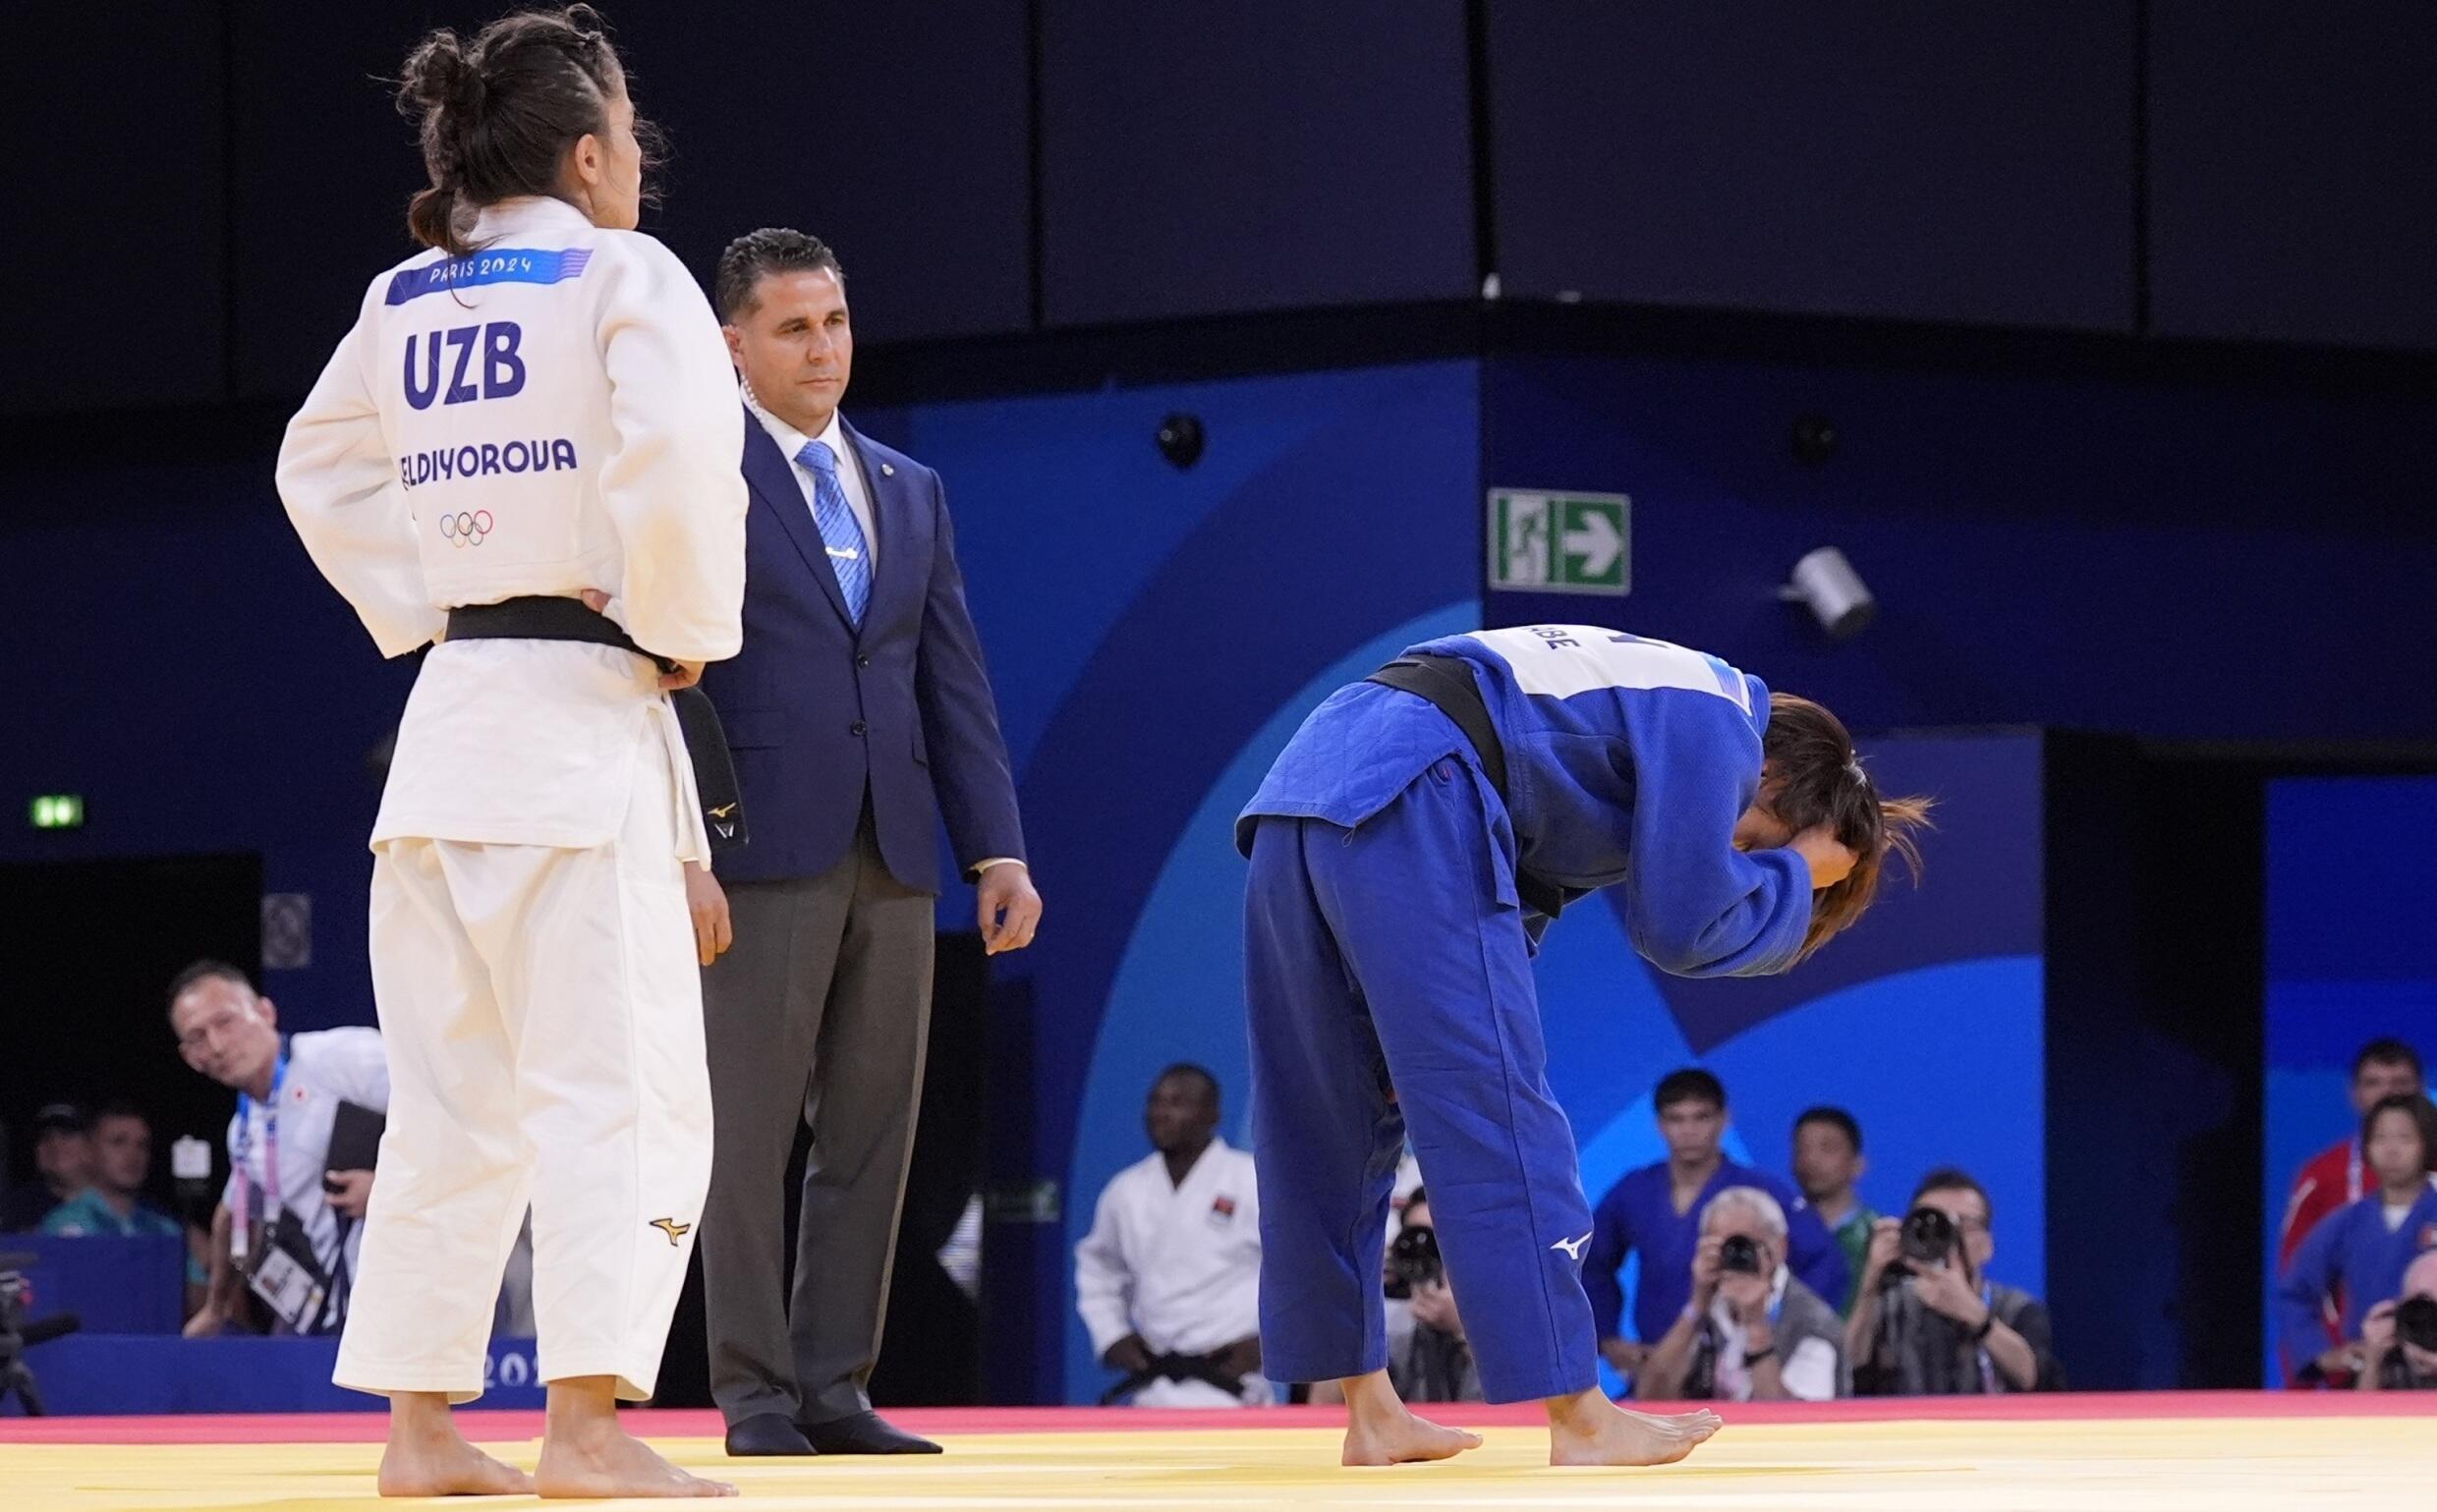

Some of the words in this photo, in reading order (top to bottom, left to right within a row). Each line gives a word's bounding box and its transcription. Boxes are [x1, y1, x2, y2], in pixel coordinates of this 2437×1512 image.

[429, 260, 475, 284] PARIS
[480, 257, 532, 276] 2024
[404, 321, 526, 411] UZB
